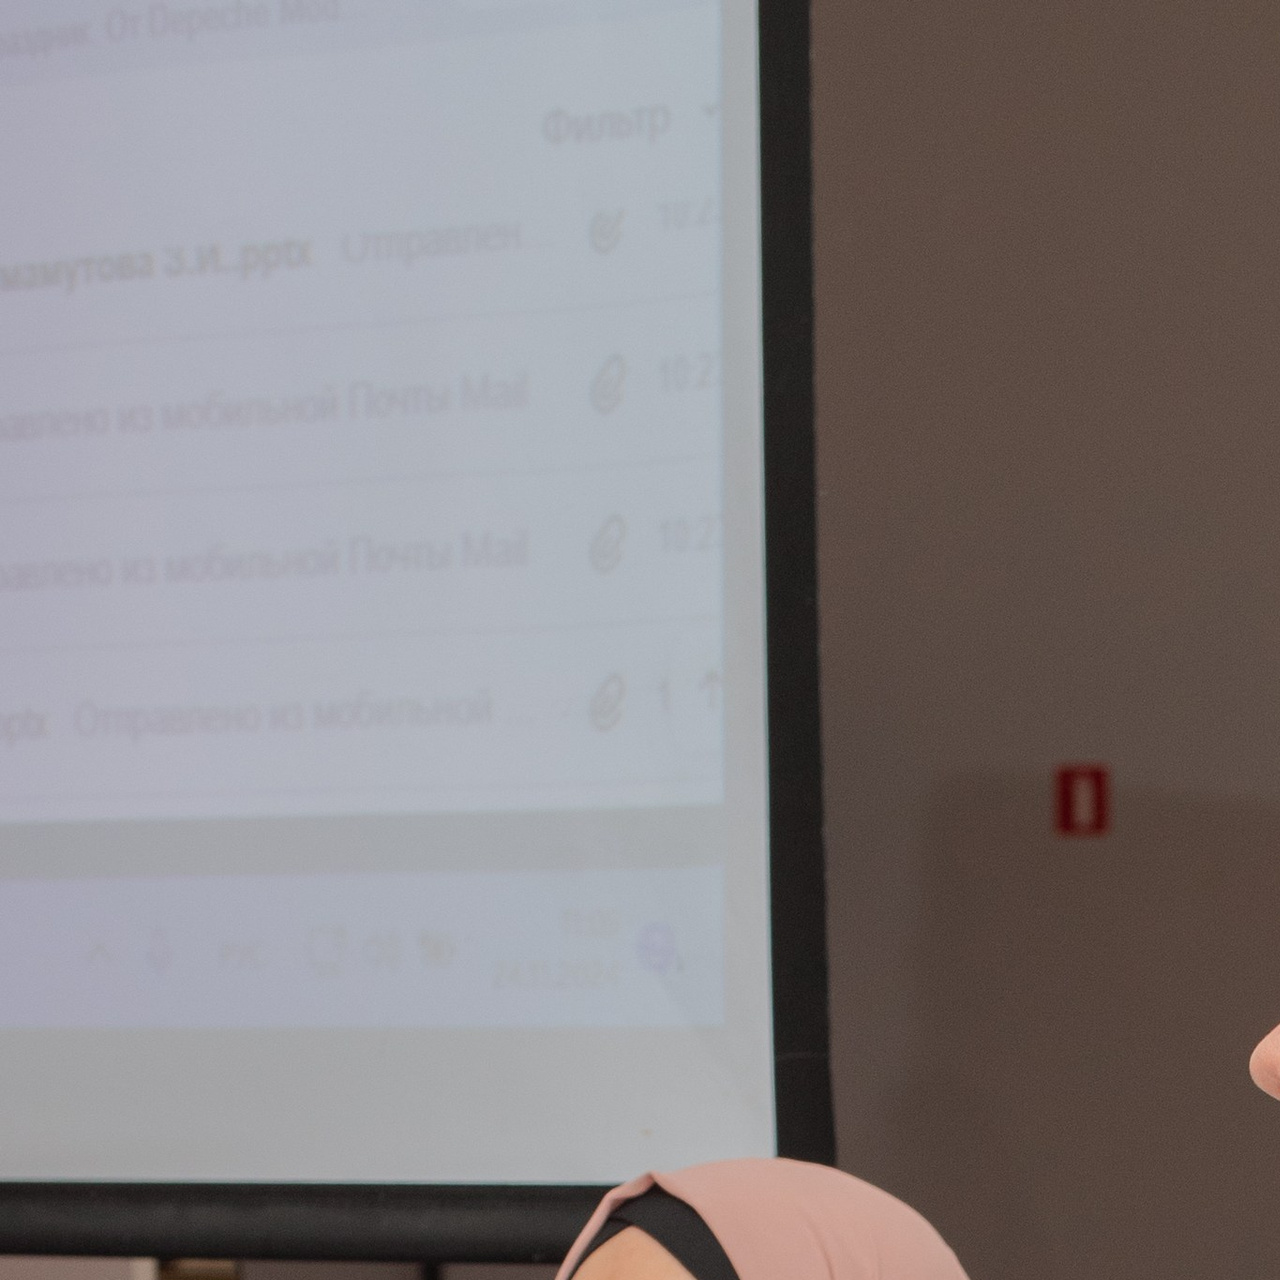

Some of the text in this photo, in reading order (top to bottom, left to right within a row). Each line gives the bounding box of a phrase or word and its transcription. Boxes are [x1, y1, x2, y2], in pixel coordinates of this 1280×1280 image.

[540, 103, 672, 144] Фильтр
[160, 385, 339, 431] мобильной
[347, 379, 451, 421] Почты
[460, 369, 531, 410] Mail
[163, 539, 340, 585] мобильной
[348, 534, 453, 577] Почты
[460, 529, 531, 568] Mail
[73, 698, 262, 745] Отправлено
[312, 687, 495, 730] мобильной
